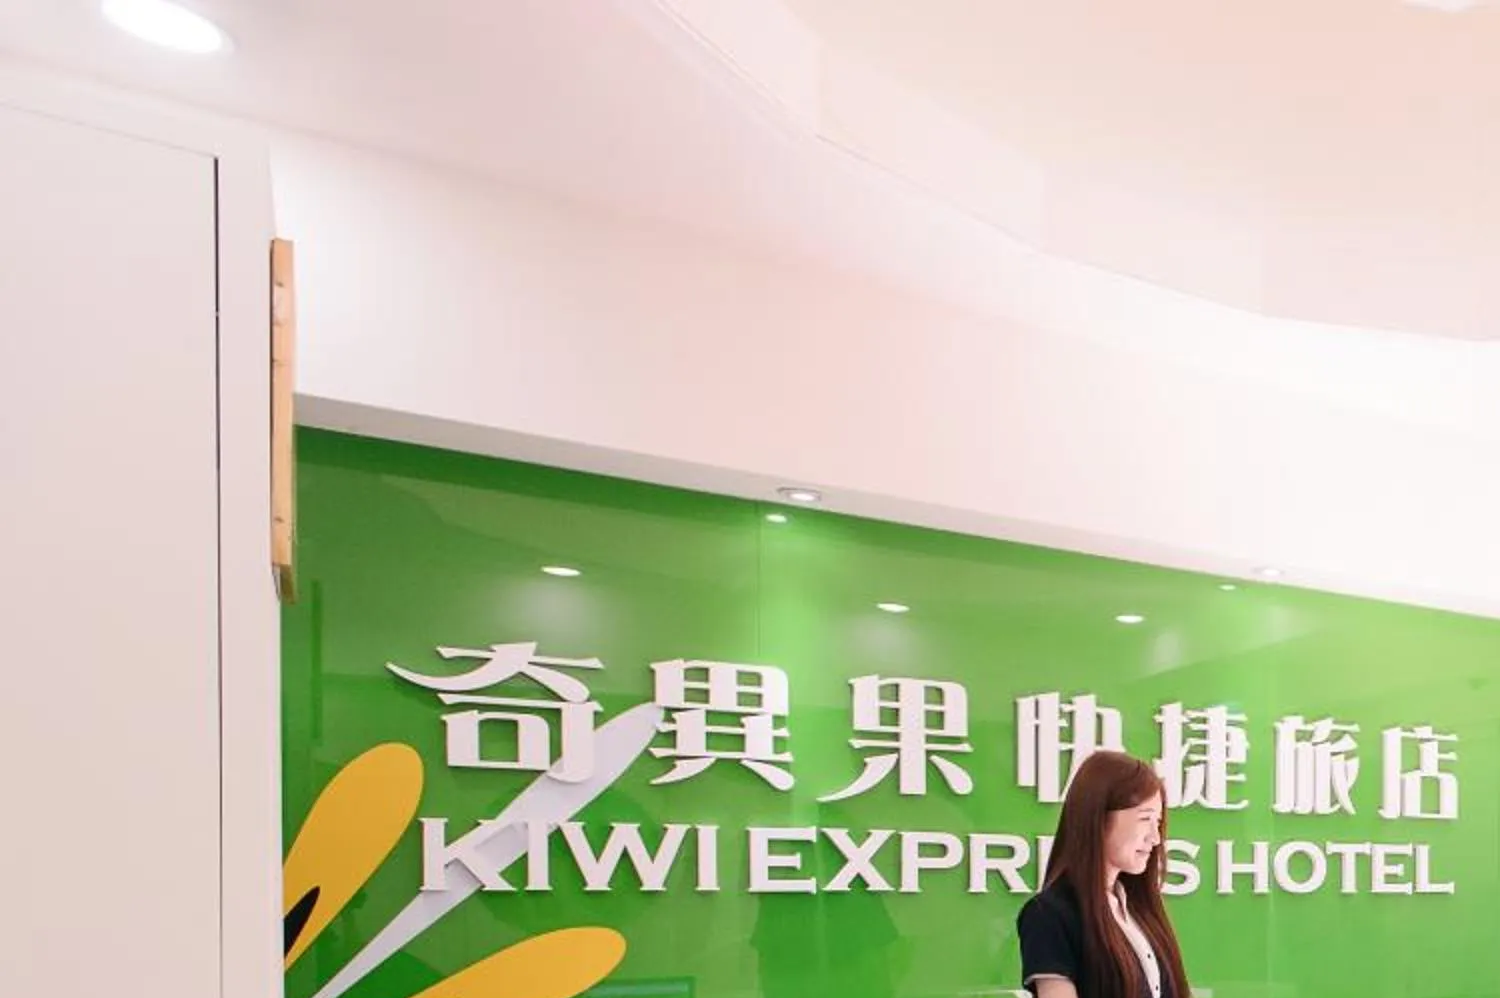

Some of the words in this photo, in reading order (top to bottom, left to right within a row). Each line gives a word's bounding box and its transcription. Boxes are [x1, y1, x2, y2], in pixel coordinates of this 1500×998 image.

[419, 817, 721, 893] KIWI
[746, 825, 1201, 896] EXPRS
[1216, 839, 1456, 896] HOTEL
